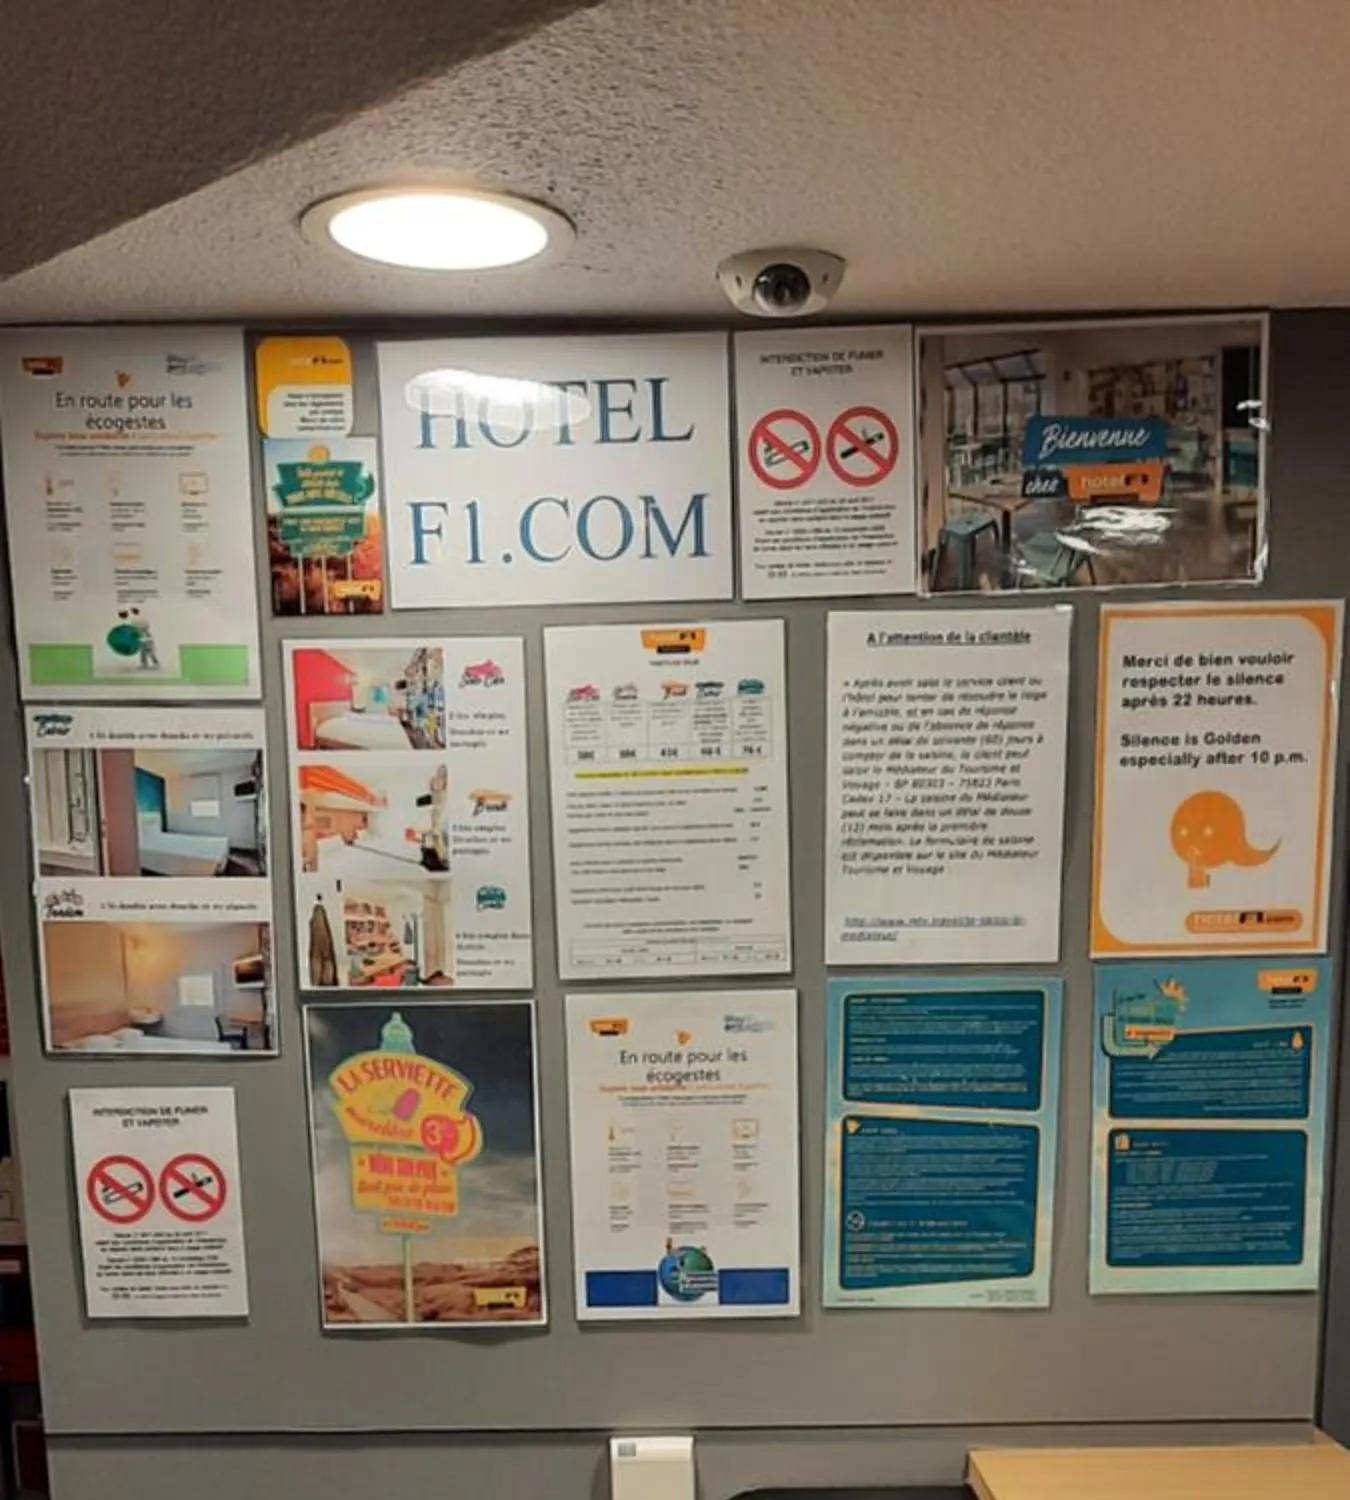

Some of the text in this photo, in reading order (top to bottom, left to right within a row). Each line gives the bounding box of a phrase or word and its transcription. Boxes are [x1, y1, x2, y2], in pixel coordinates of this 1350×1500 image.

[56, 392, 192, 411] En route pour les
[86, 413, 166, 431] écogestes
[417, 377, 695, 449] HOTEL
[1039, 422, 1152, 459] Bienvenue
[1025, 477, 1060, 496] chez
[408, 493, 710, 565] F1.COM
[867, 632, 876, 643] A
[946, 631, 961, 642] de
[965, 630, 976, 642] la
[1123, 652, 1295, 667] Merci de bien vouloir
[1122, 672, 1284, 689] respecter le silence
[1121, 693, 1257, 709] après 22 heures.
[1121, 732, 1261, 747] Silence is Golden
[1120, 751, 1308, 769] especially after 10 p.m.
[620, 1049, 748, 1069] En route pour les
[360, 1058, 458, 1100] SERVIETTE
[646, 1068, 721, 1086] écogestes
